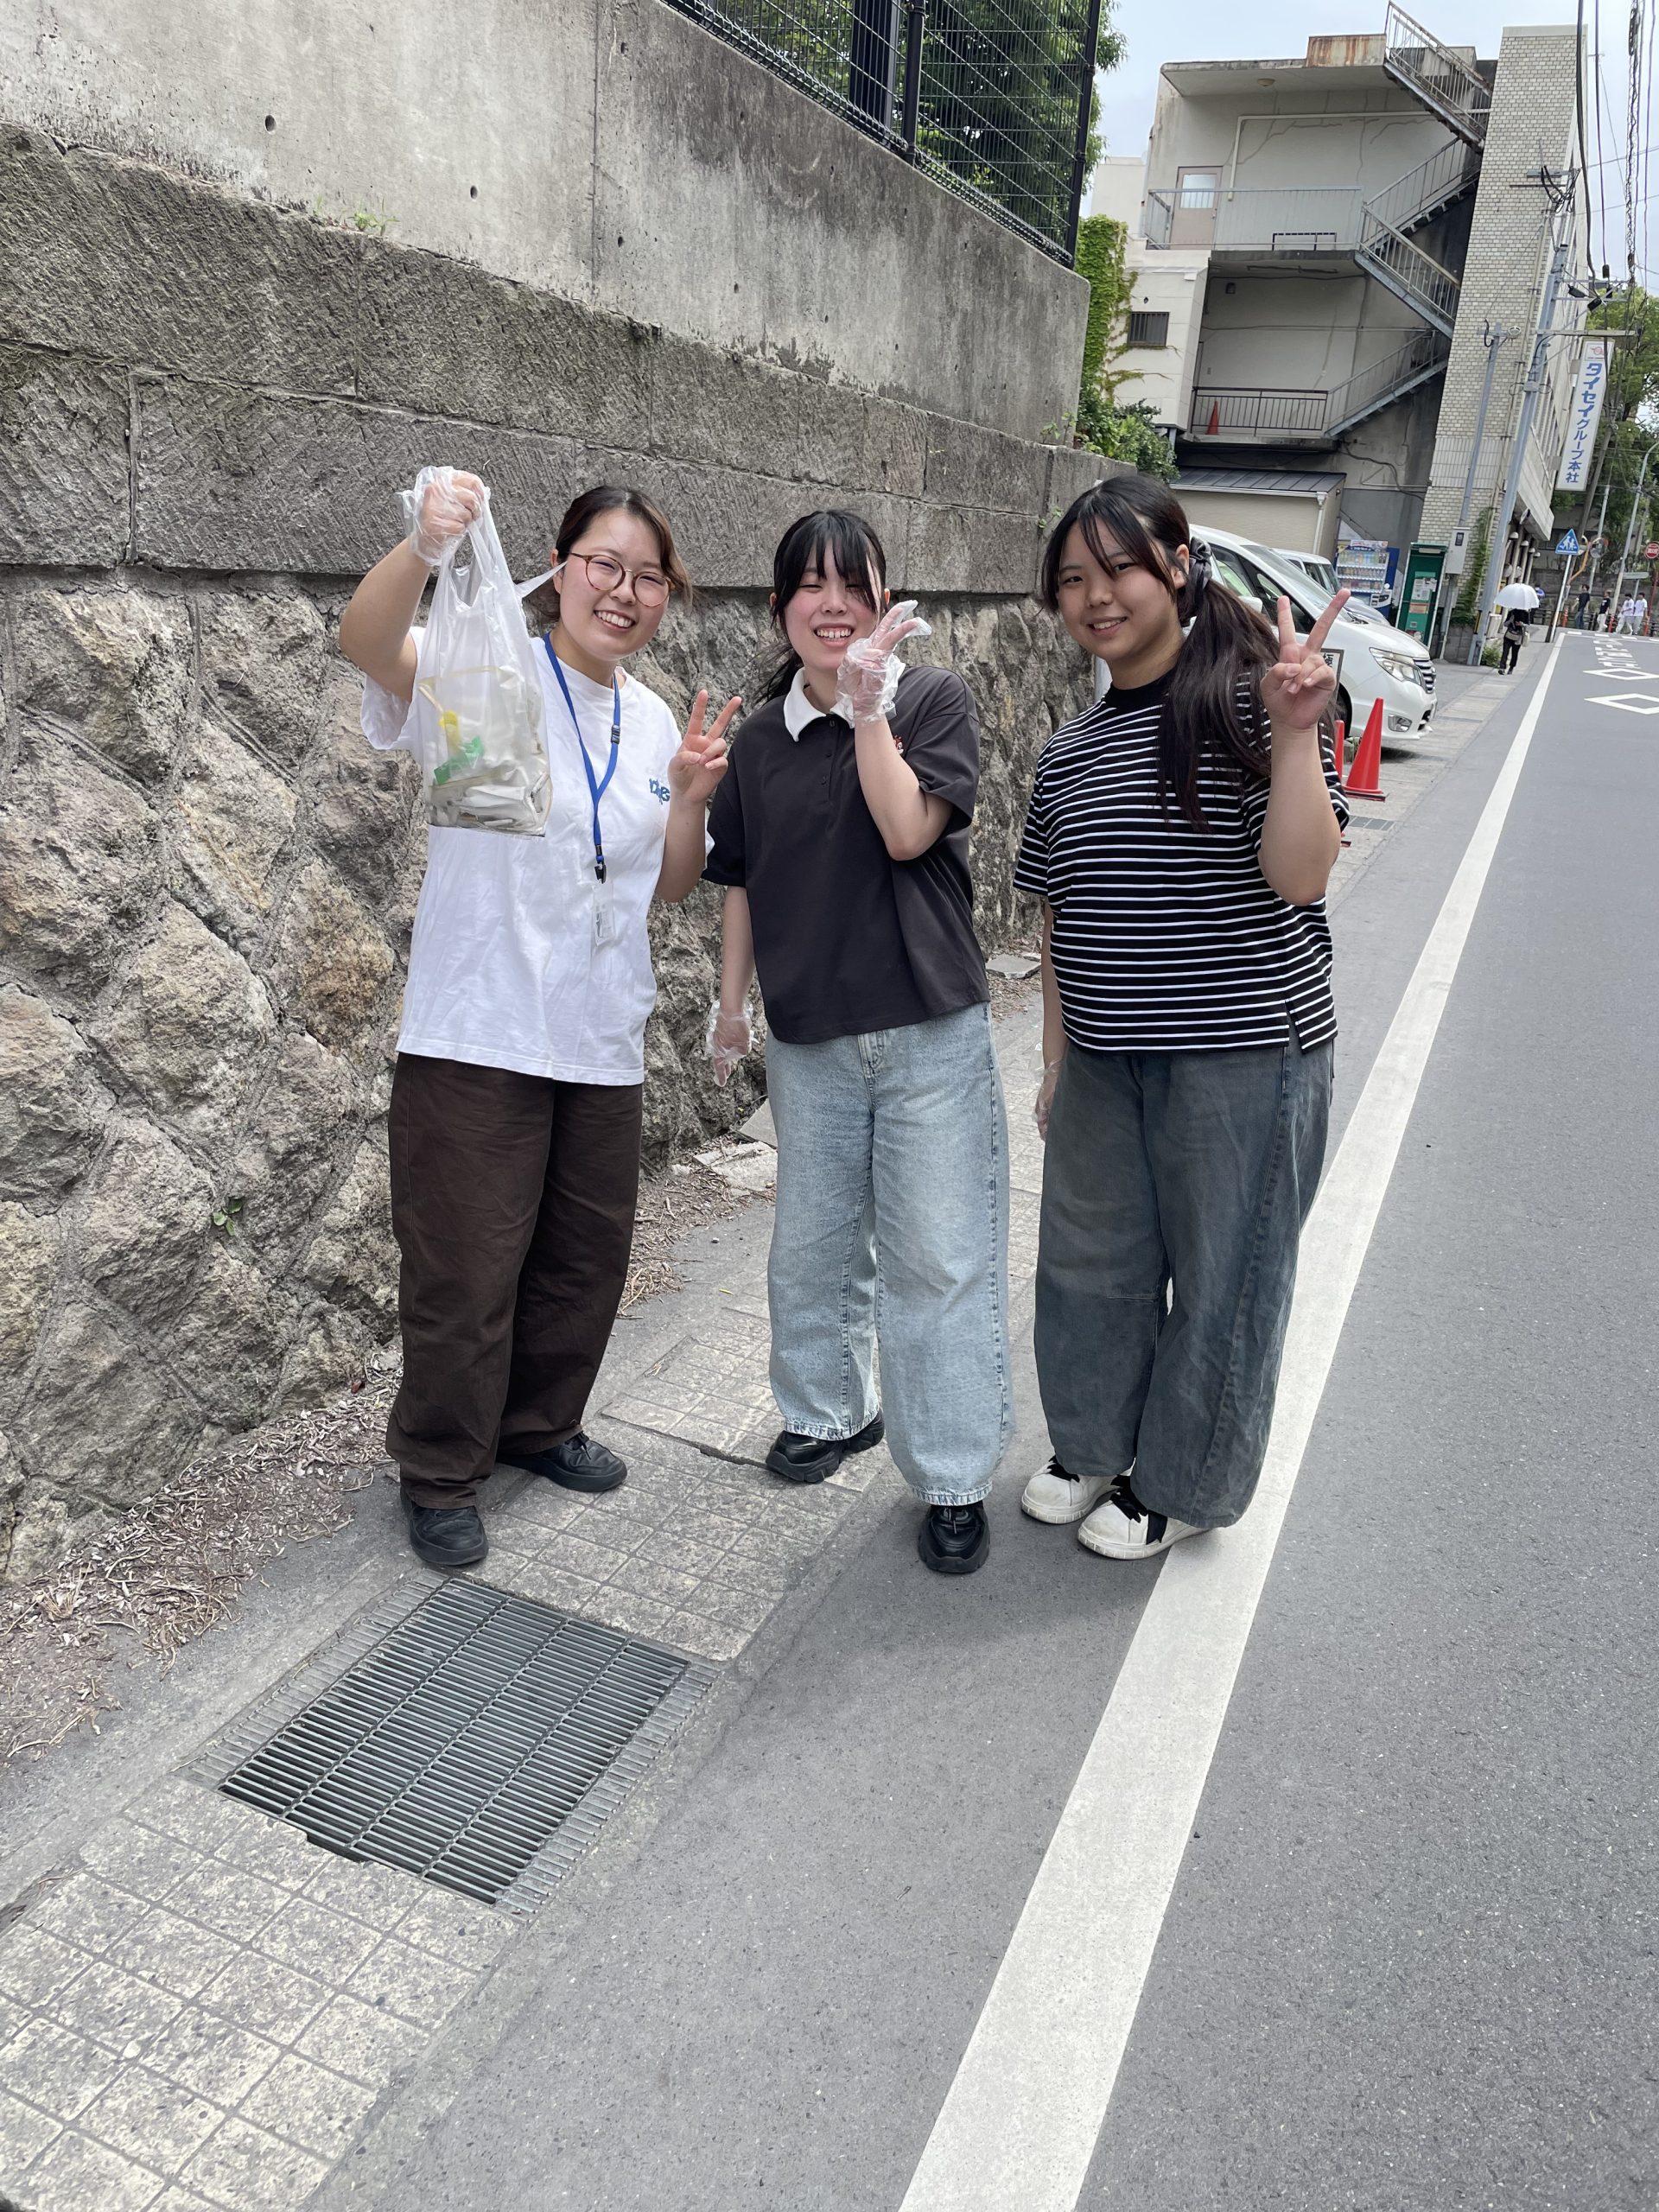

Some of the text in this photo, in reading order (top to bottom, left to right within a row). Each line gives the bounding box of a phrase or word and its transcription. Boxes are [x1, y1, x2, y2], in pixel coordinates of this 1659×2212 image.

[1565, 362, 1602, 483] タイセイグループ本社
